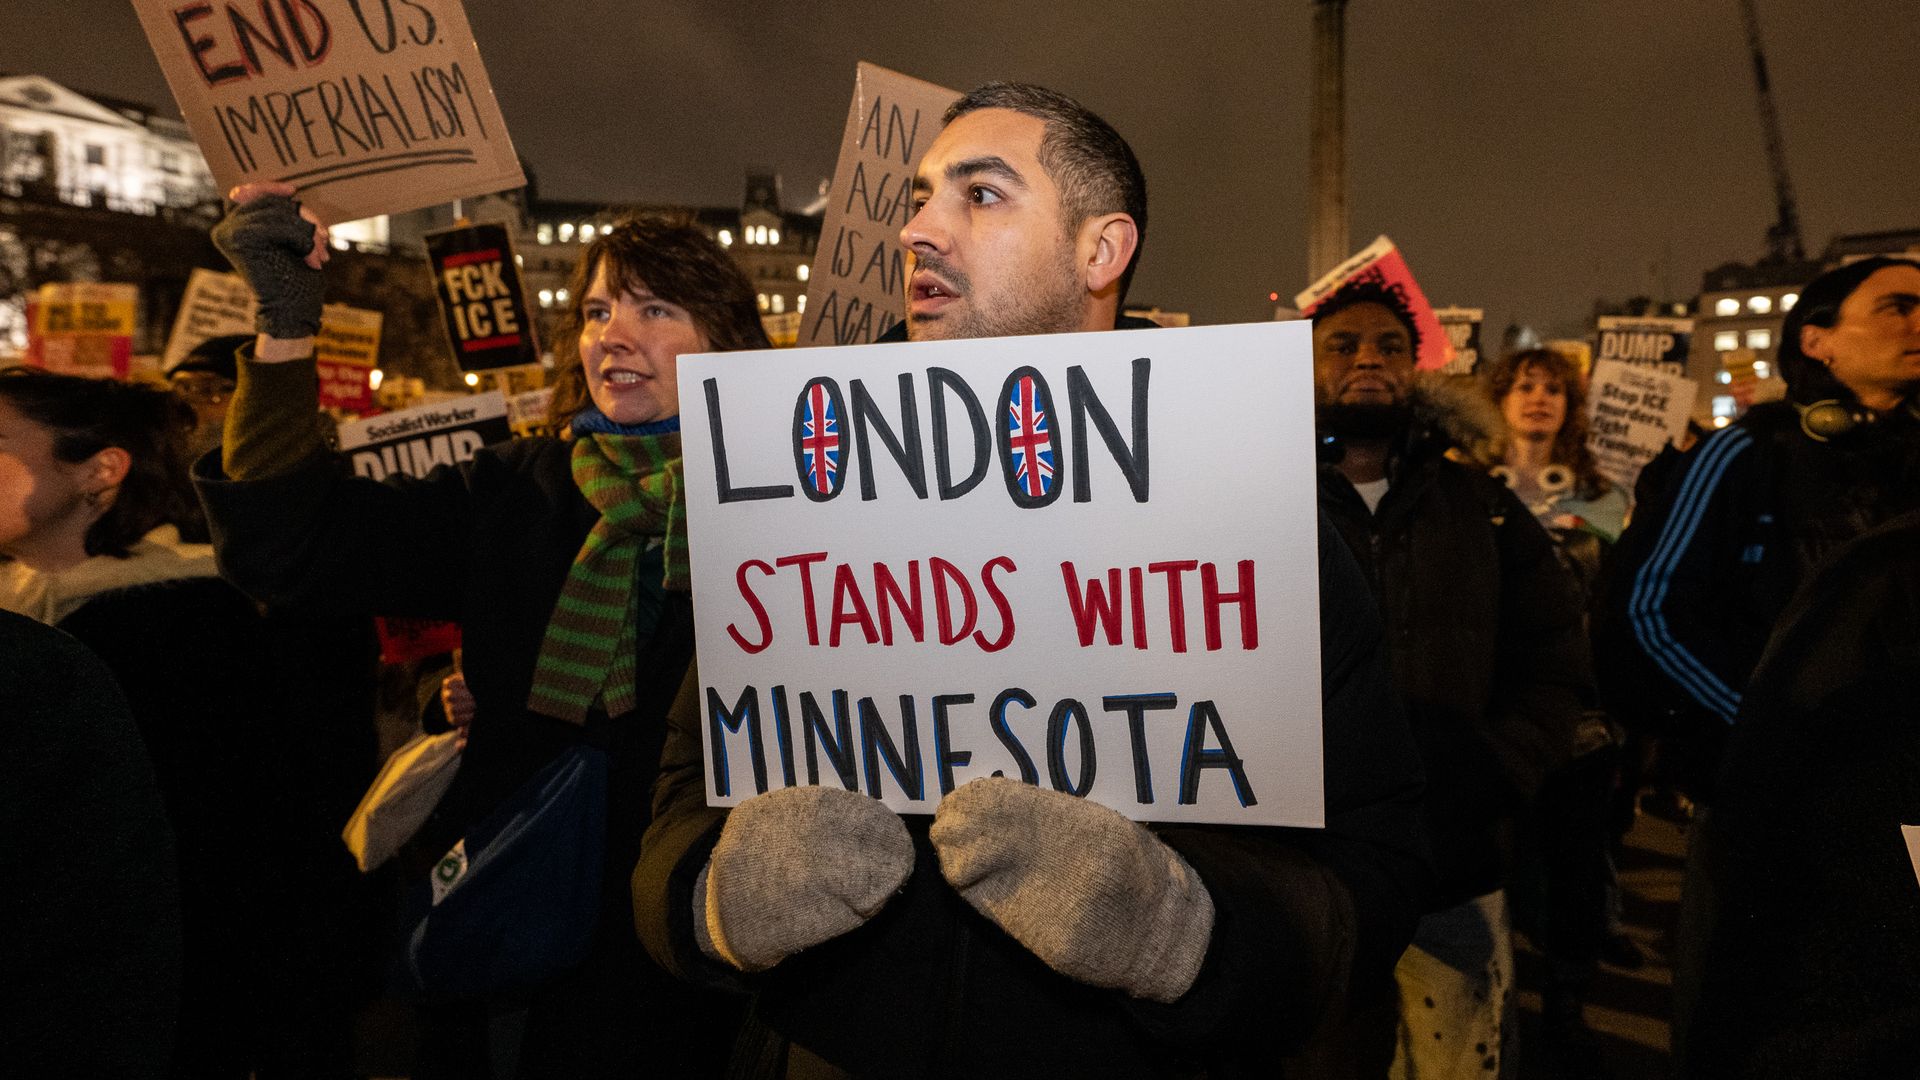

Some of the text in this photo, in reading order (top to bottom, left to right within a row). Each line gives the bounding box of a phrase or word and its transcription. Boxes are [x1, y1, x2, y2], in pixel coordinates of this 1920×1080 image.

[172, 0, 443, 87] END U.S.
[213, 62, 488, 173] IMPERIALISM
[860, 95, 920, 165] AN
[846, 161, 913, 227] AGA
[831, 226, 863, 278] IS
[443, 260, 510, 305] FCK
[453, 297, 520, 341] ICE
[1601, 332, 1675, 361] DUMP
[365, 407, 477, 441] Socialist Worker
[1603, 382, 1668, 411] Stop ICE
[352, 429, 485, 482] DUMP
[703, 358, 1151, 509] LONDON
[726, 552, 1259, 654] STANDS WITH
[706, 685, 1258, 807] MINNESOTA
